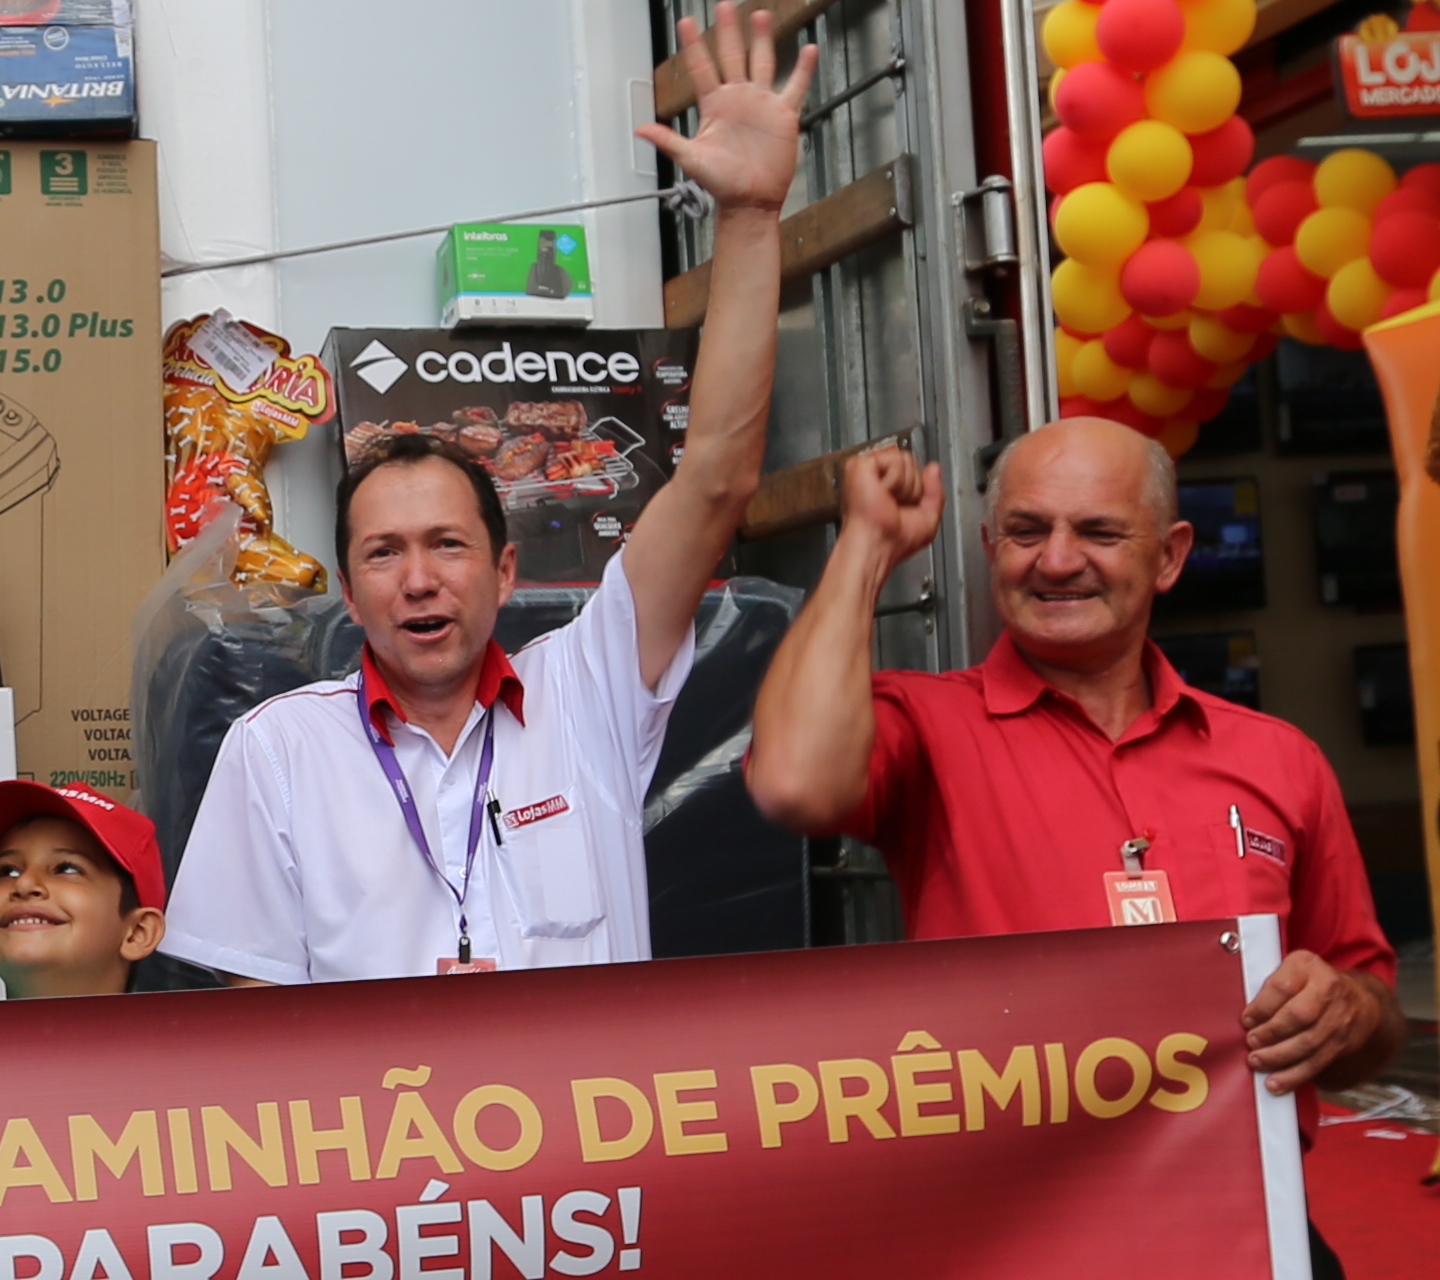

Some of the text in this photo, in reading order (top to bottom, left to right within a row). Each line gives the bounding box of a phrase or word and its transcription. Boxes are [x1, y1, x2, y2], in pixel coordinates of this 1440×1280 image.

[54, 152, 74, 176] 3
[67, 312, 134, 338] Plus
[416, 341, 640, 383] cadence
[71, 708, 131, 722] VOLTAGE
[569, 1069, 728, 1164] DE
[749, 1030, 1209, 1149] PRÊMIOS
